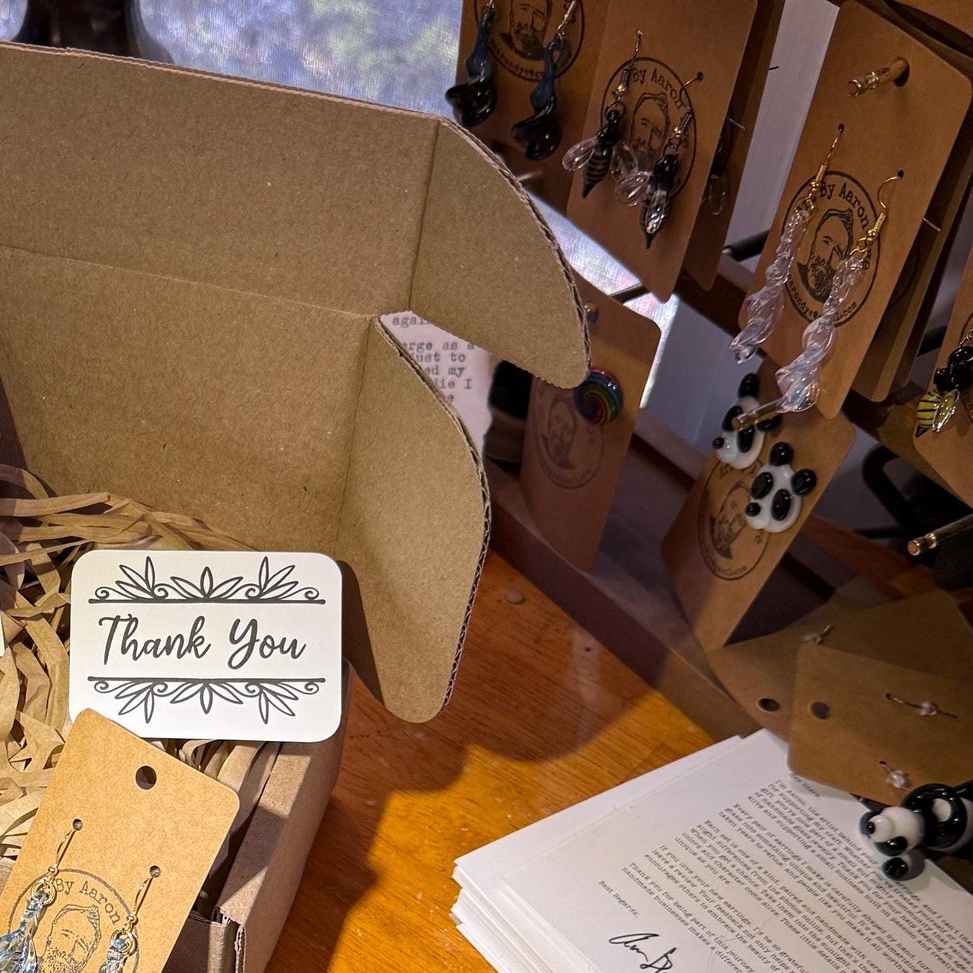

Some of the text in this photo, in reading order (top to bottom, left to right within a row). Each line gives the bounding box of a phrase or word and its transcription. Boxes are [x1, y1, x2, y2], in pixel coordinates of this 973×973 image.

[450, 352, 466, 362] to
[448, 367, 465, 378] my
[98, 613, 307, 669] Thank You
[55, 878, 121, 925] By Aaron
